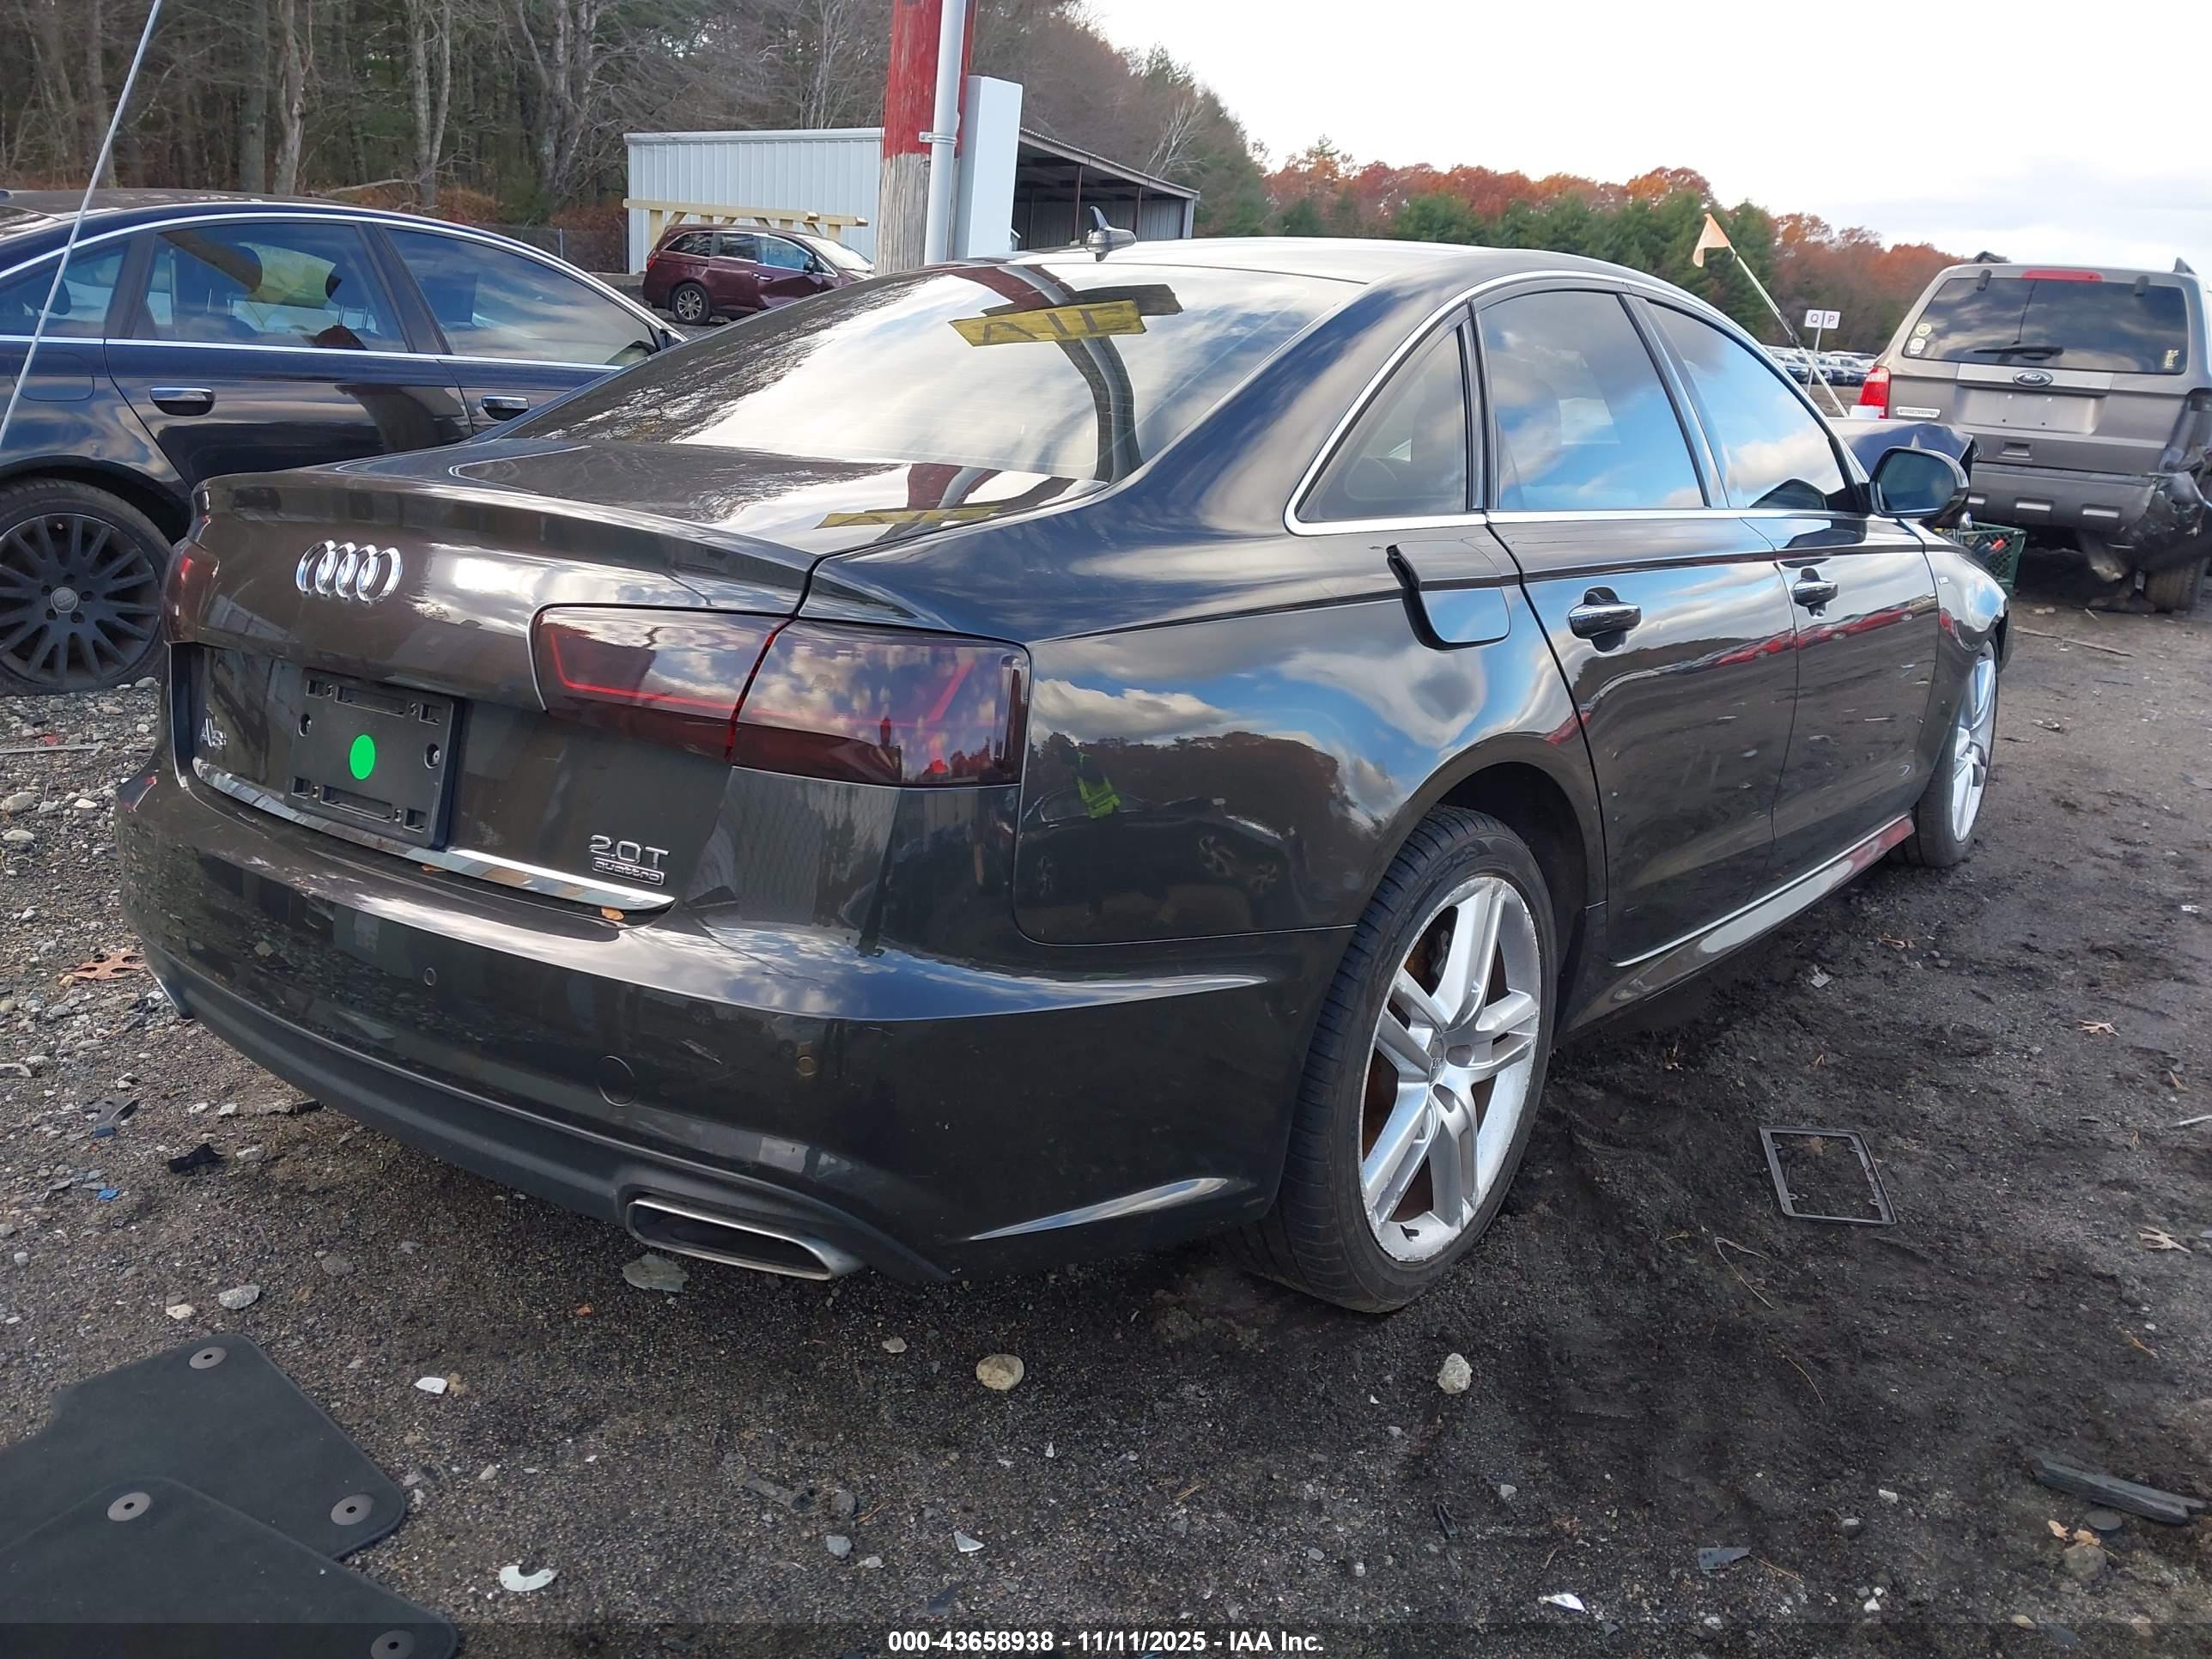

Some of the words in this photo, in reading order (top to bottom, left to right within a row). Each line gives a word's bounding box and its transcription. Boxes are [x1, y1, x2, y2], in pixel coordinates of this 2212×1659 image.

[1810, 313, 1820, 323] Q
[1827, 315, 1836, 324] P
[588, 835, 670, 869] 2.0T
[594, 860, 660, 881] quattro
